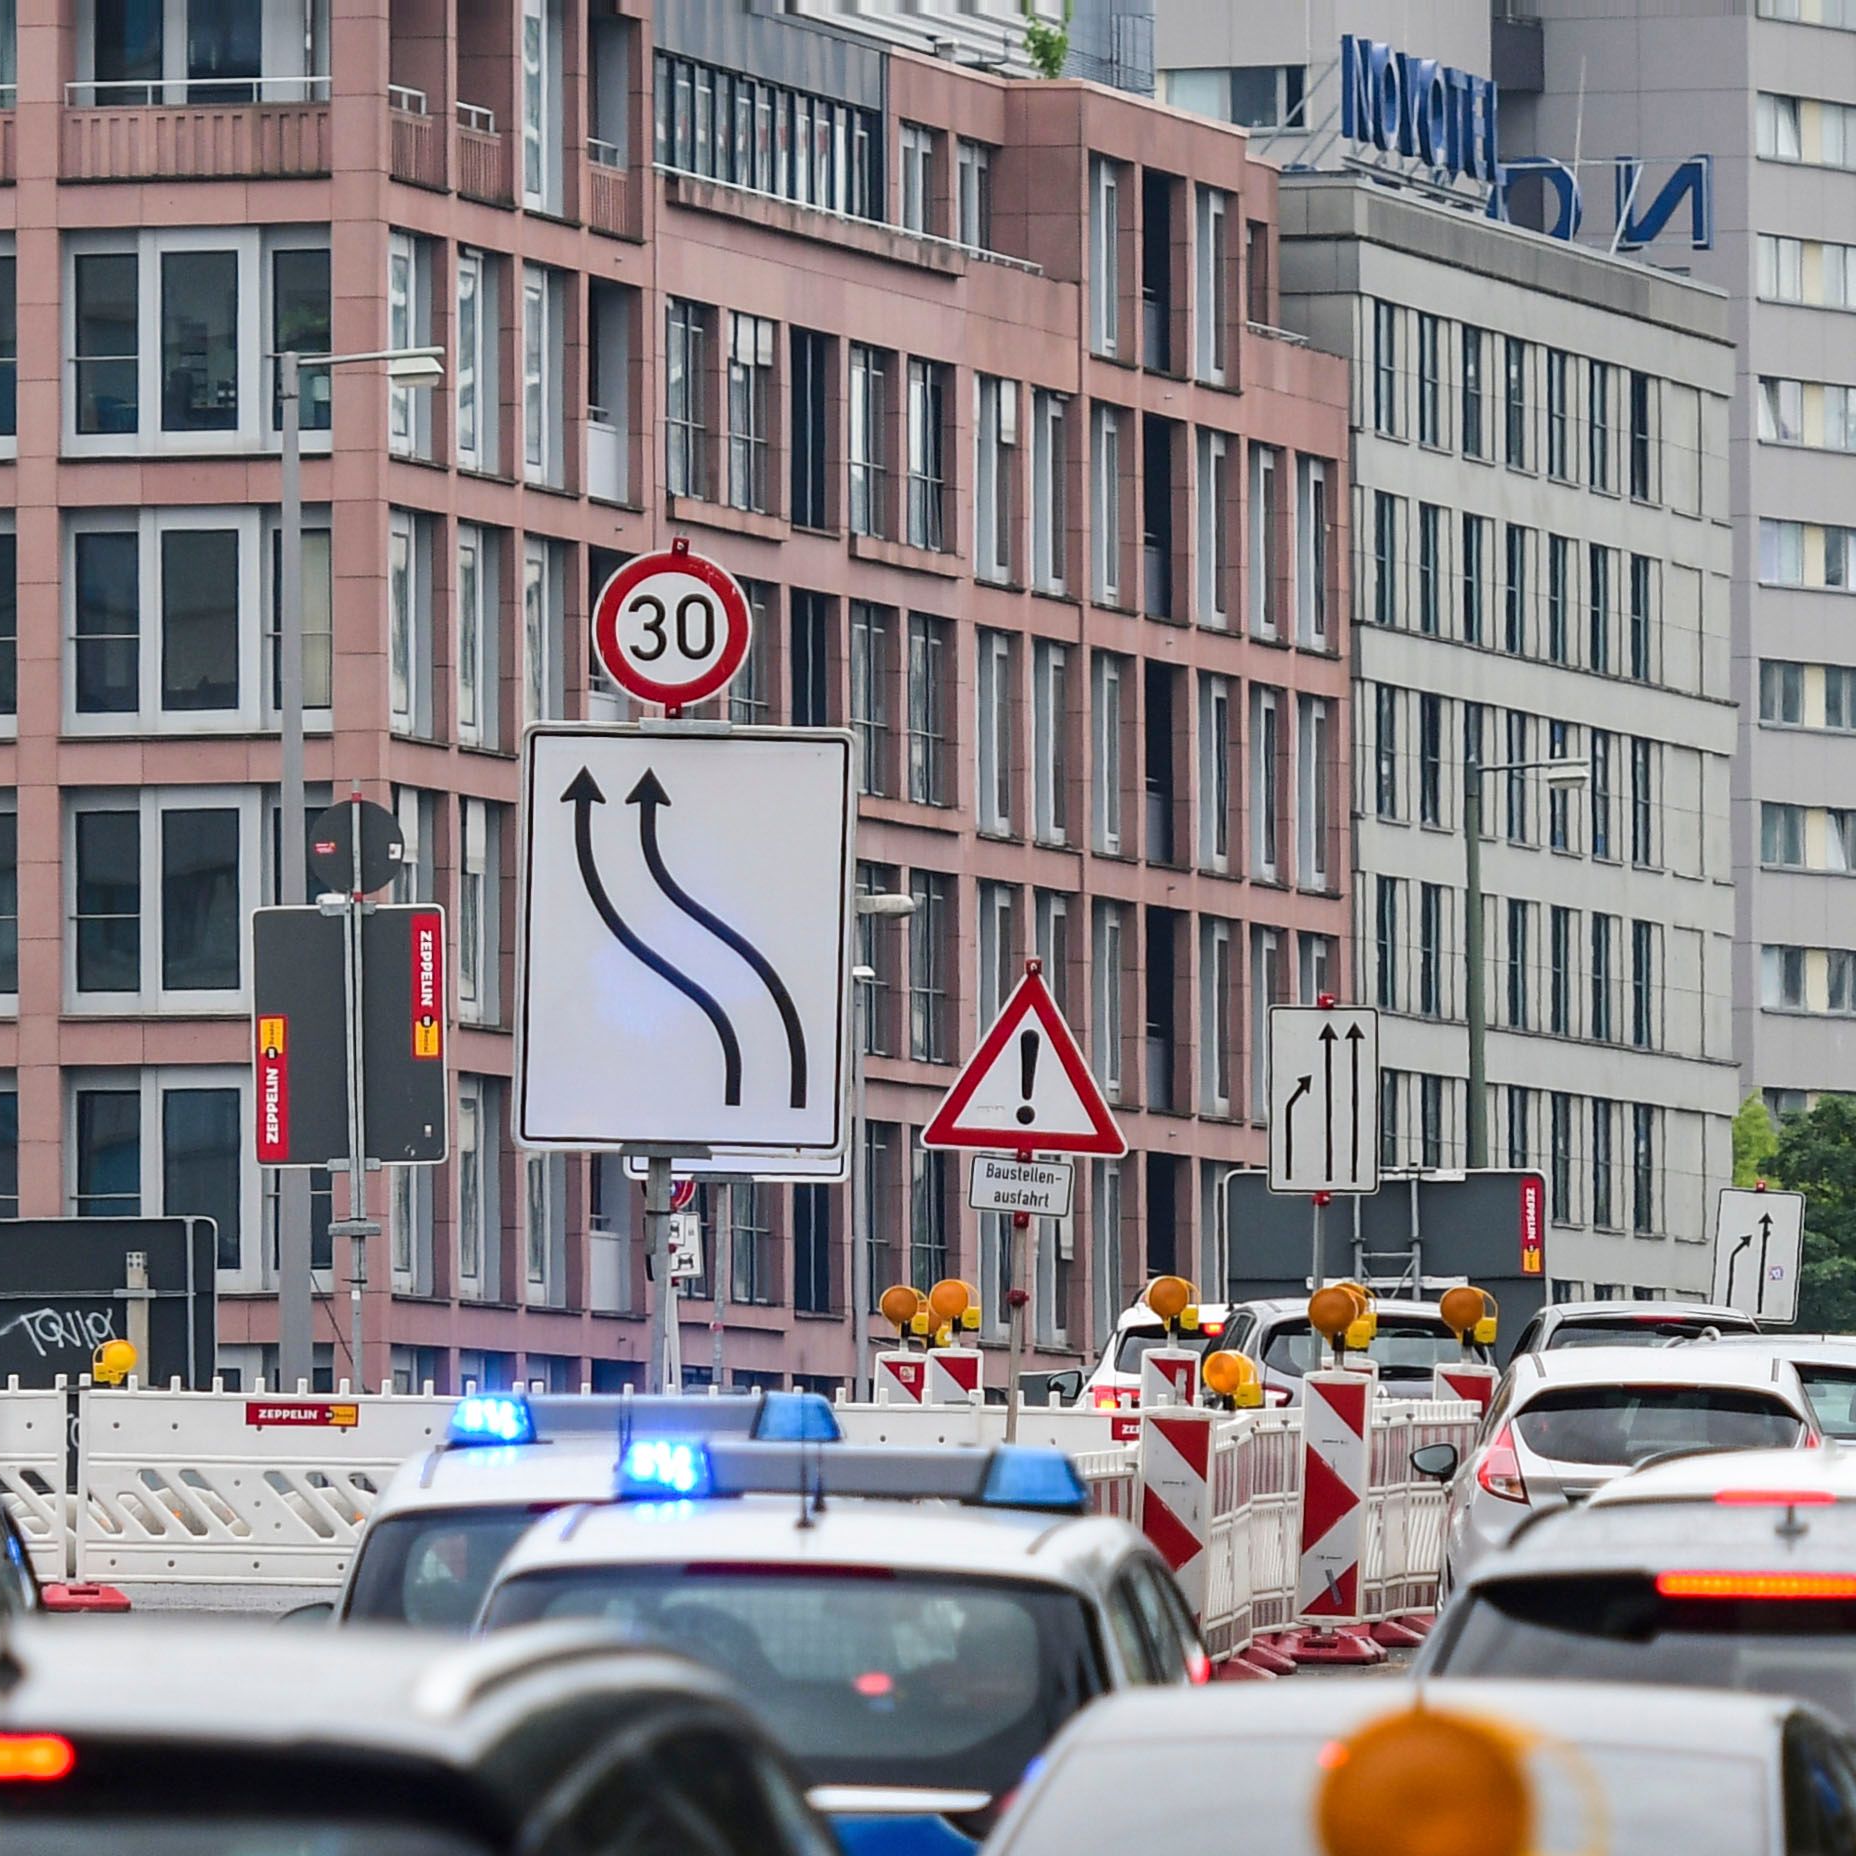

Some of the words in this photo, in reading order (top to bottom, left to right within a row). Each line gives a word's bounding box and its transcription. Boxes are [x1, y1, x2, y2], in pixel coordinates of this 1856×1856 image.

[1341, 33, 1506, 186] NOVOTEL
[627, 593, 715, 662] 30
[420, 931, 432, 1007] ZEPPELIN
[266, 1067, 278, 1144] ZEPPELIN
[986, 1162, 1062, 1184] Baustellen-
[994, 1189, 1049, 1208] ausfahrt
[258, 1408, 318, 1420] ZEPPELIN
